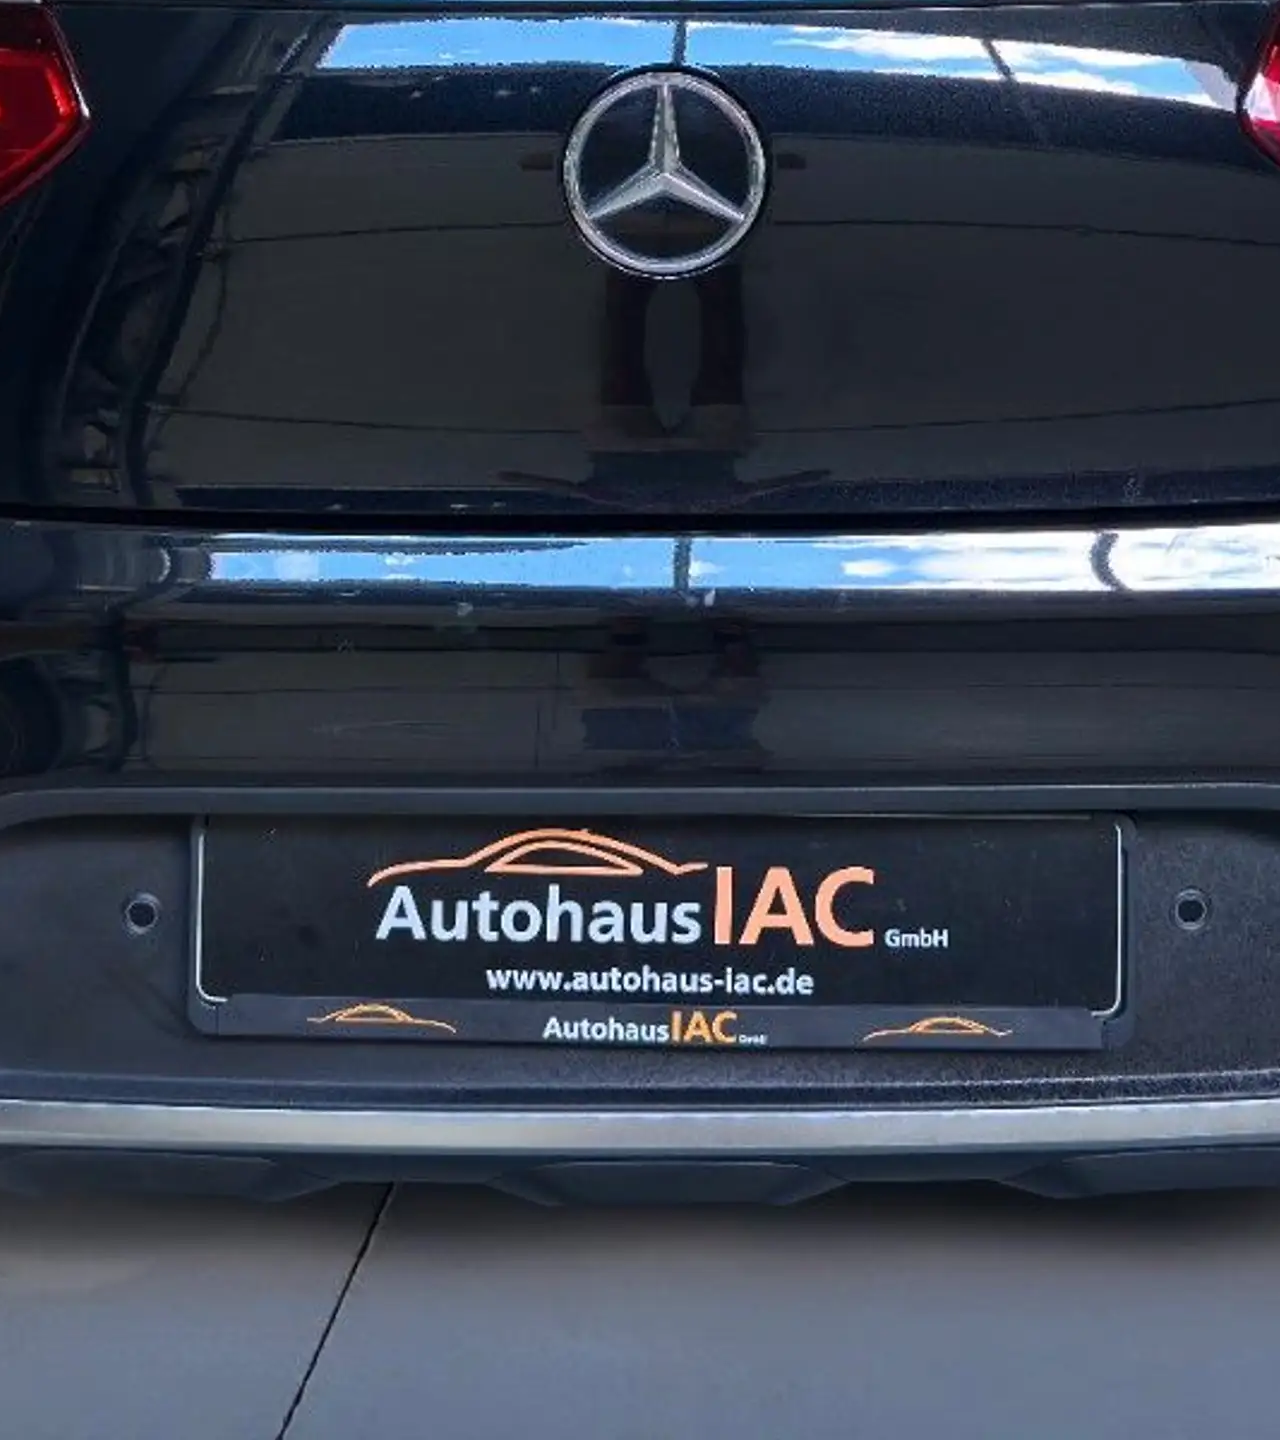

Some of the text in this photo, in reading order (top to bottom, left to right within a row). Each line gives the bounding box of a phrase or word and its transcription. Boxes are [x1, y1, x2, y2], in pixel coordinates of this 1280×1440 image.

[375, 866, 949, 949] Autohaus IAC GmbH
[485, 964, 815, 995] www.autohaus-iac.de
[542, 1016, 670, 1043] Autohaus
[671, 1010, 738, 1043] IAC
